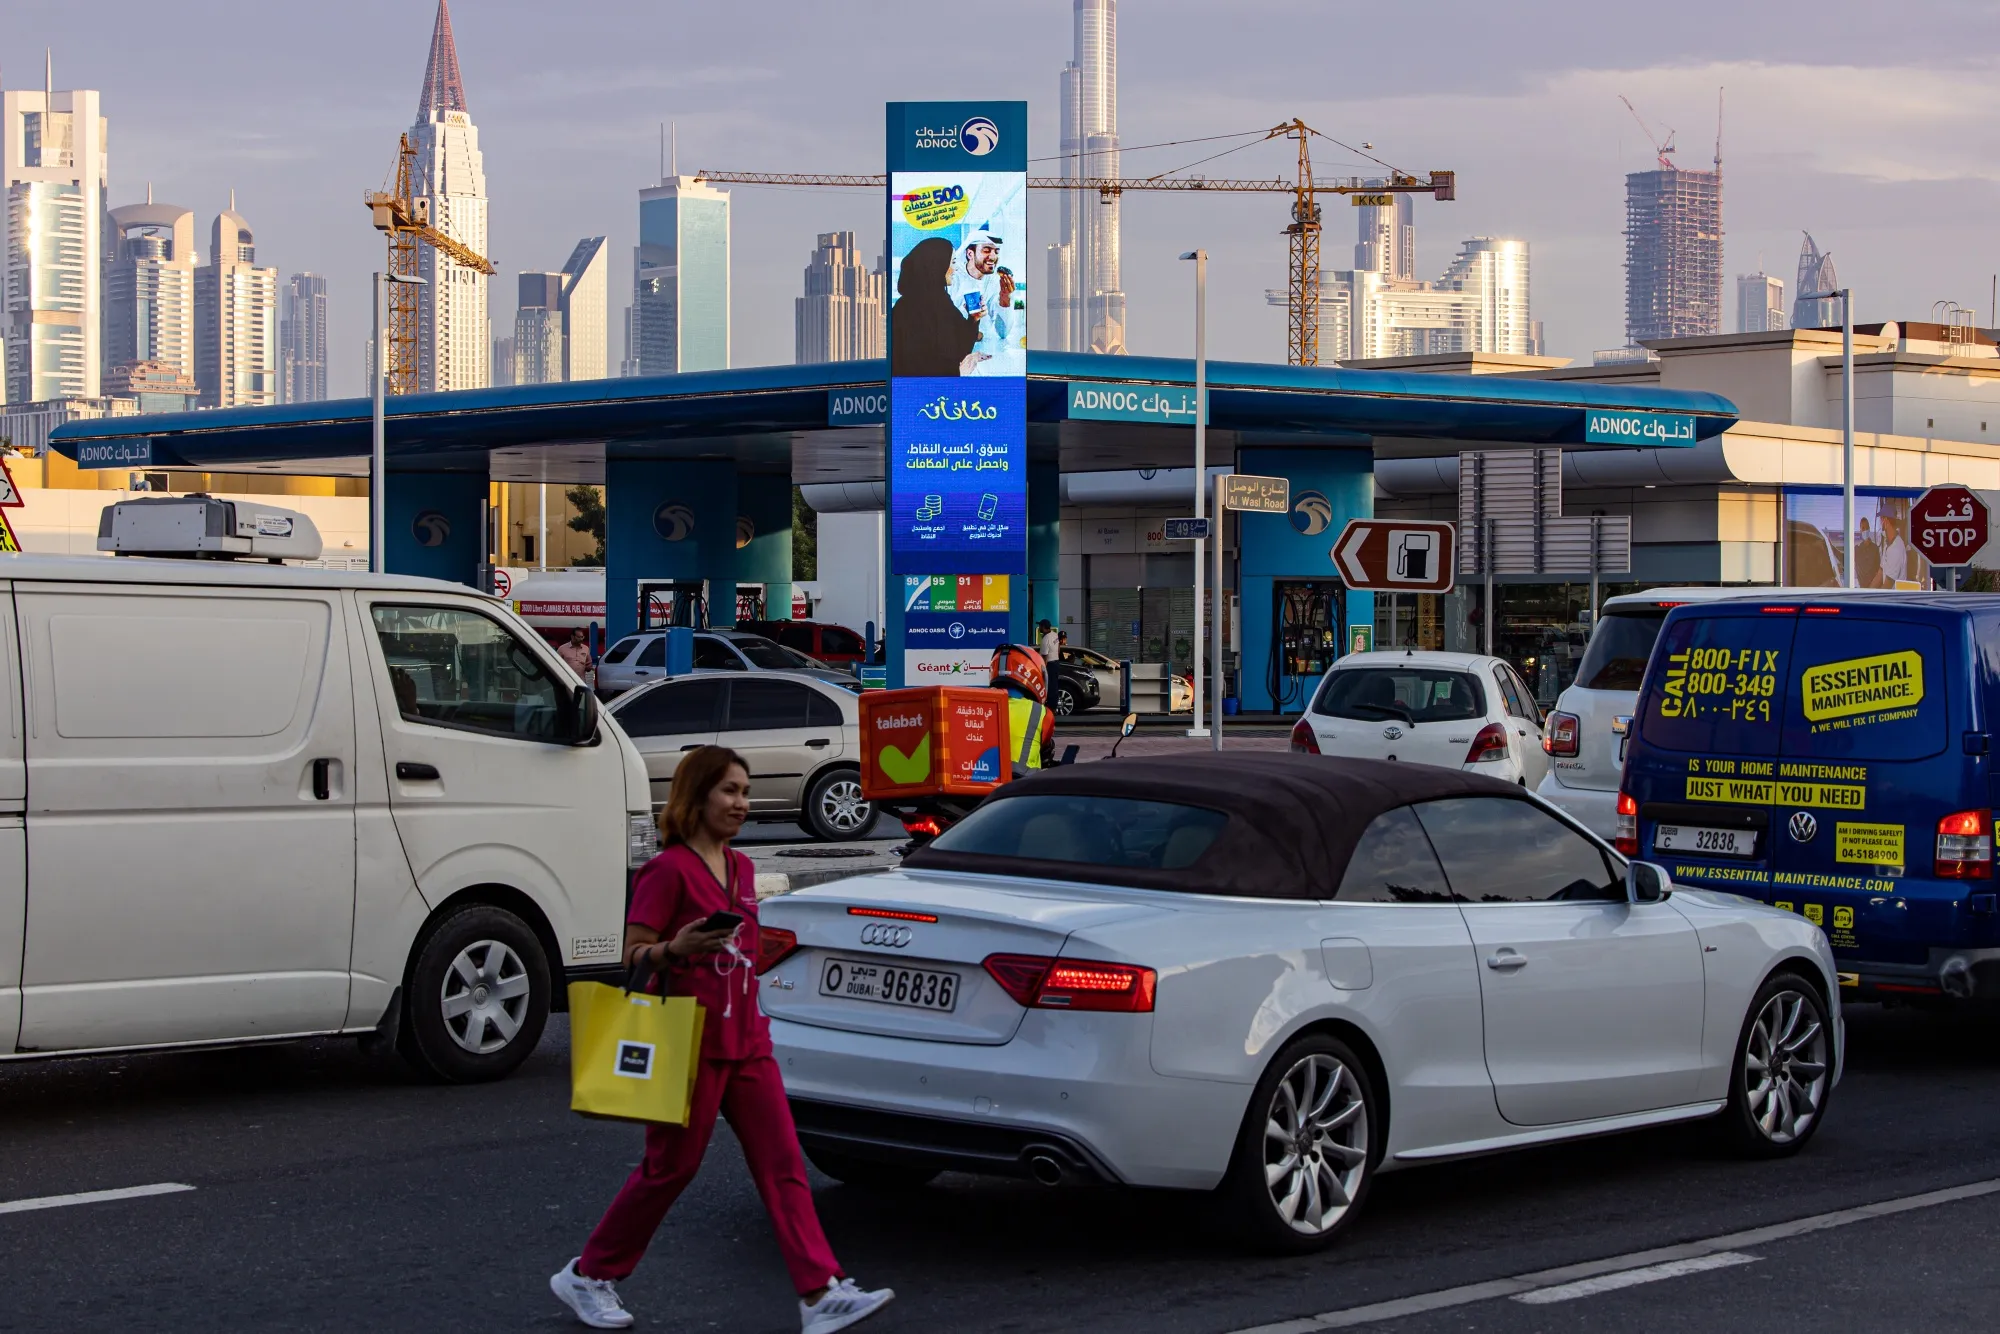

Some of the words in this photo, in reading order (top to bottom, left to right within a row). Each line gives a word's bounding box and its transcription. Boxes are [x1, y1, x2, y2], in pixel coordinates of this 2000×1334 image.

[916, 125, 957, 138] أدنوك
[916, 138, 957, 148] ADNOC
[933, 185, 964, 204] 500
[832, 395, 886, 415] ADNOC
[1074, 390, 1138, 411] ADNOC
[1141, 393, 1196, 419] دنوك
[1590, 417, 1640, 436] ADNOC
[1644, 419, 1693, 442] أدنوك
[80, 446, 114, 461] ADNOC
[114, 440, 150, 463] أدنوك
[1261, 483, 1285, 497] شارع
[1229, 496, 1237, 506] Al
[1242, 496, 1260, 506] Wasl
[1264, 498, 1285, 508] Road
[1924, 497, 1973, 522] قف
[1177, 522, 1188, 536] 49
[1922, 528, 1976, 548] STOP
[907, 577, 919, 585] 98
[933, 577, 945, 585] 95
[959, 577, 971, 585] 91
[985, 577, 992, 585] D
[918, 662, 951, 671] Géant
[1691, 649, 1779, 672] 800-FIX
[1661, 648, 1691, 717] CALL
[1687, 673, 1776, 697] 800-349
[1810, 660, 1912, 694] ESSENTIAL
[976, 707, 984, 715] 30
[876, 714, 922, 730] talabat
[1811, 725, 1816, 733] A
[1818, 723, 1831, 732] WE
[1832, 720, 1851, 730] WILL
[1853, 716, 1866, 726] FIX
[1868, 715, 1876, 723] IT
[1878, 709, 1918, 722] COMPANY
[962, 760, 989, 774] طلبات
[1689, 759, 1700, 772] IS
[1706, 760, 1735, 774] YOUR
[1741, 761, 1773, 776] HOME
[1780, 764, 1866, 780] MAINTENANCE
[1688, 781, 1724, 797] JUST
[1730, 783, 1773, 801] WHAT
[1781, 786, 1812, 804] YOU
[1819, 788, 1861, 805] NEED
[1664, 837, 1671, 848] C
[1696, 831, 1735, 850] 32838
[1862, 838, 1882, 846] PLEASE
[1842, 848, 1898, 861] 04-5184900
[770, 976, 794, 990] A5
[847, 982, 874, 996] DUBAI
[881, 970, 952, 1007] 96836
